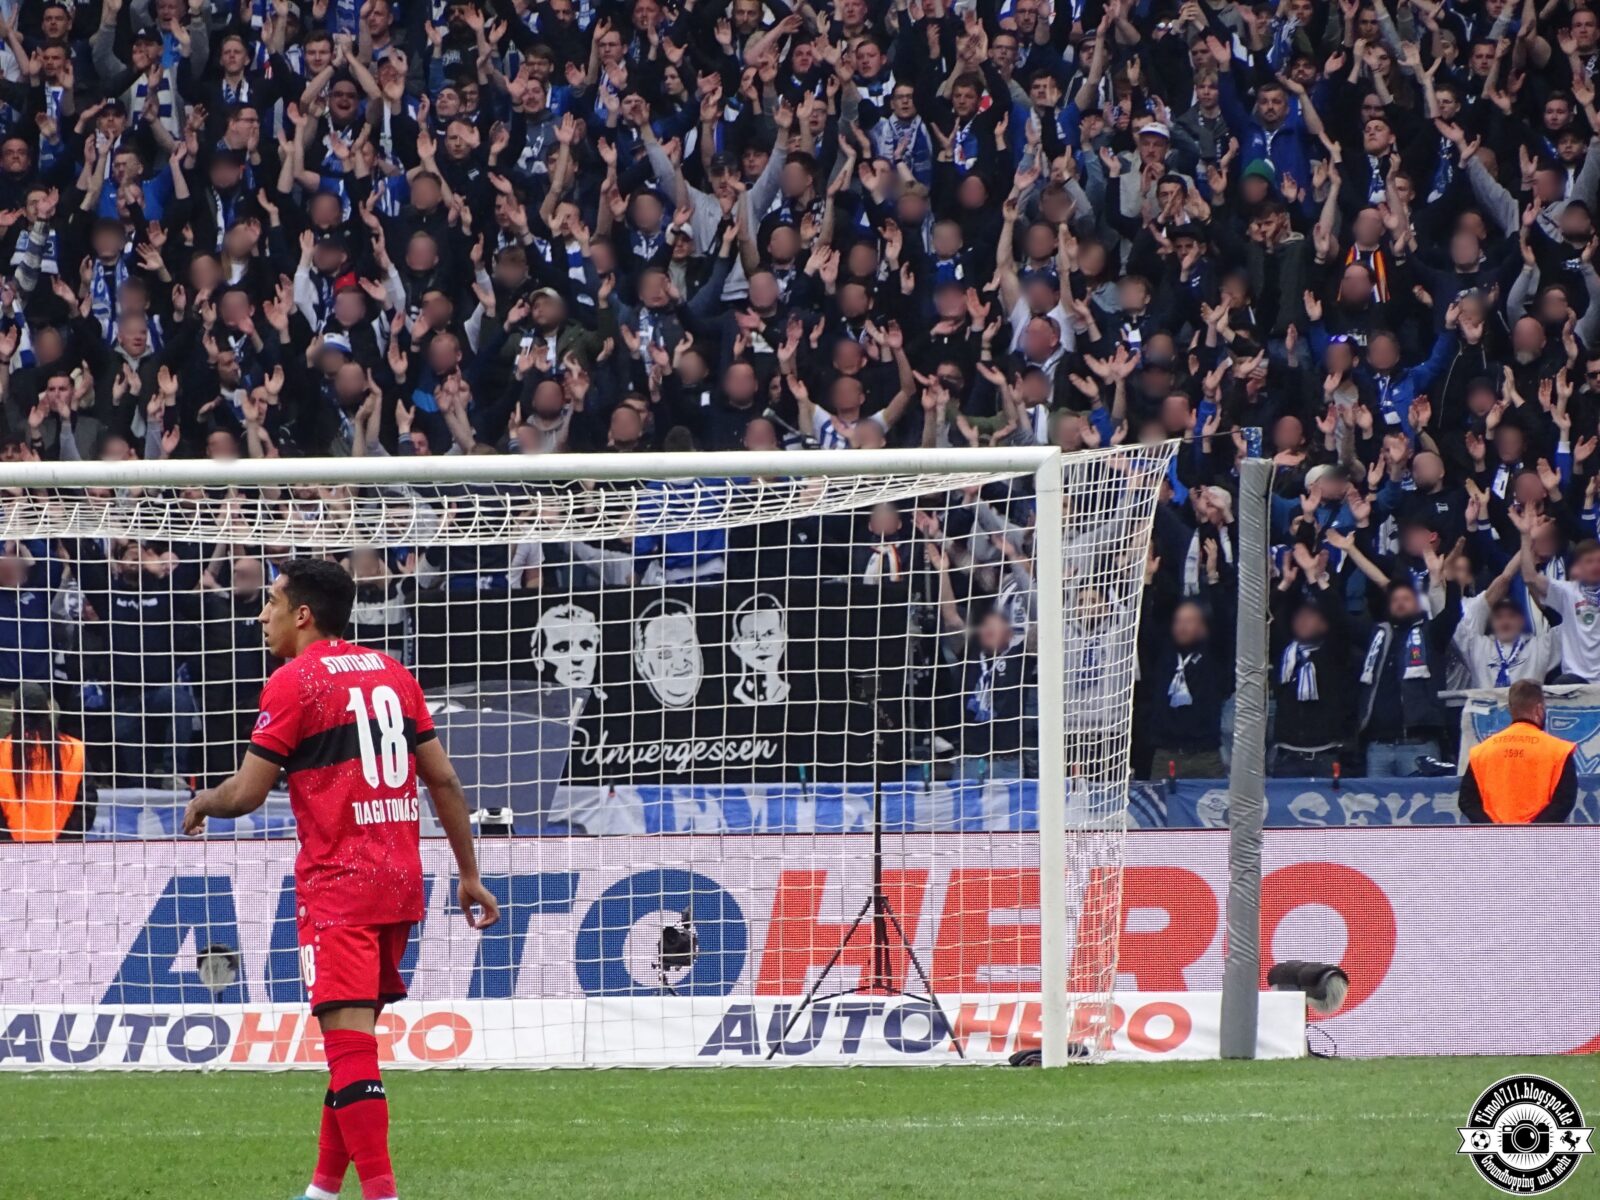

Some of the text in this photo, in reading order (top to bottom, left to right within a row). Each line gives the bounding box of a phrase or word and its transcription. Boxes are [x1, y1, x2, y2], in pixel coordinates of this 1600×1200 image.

[320, 653, 386, 675] STUTTGART
[346, 685, 408, 789] 18
[571, 725, 777, 774] Unvergessen
[1493, 735, 1540, 745] STEWARD
